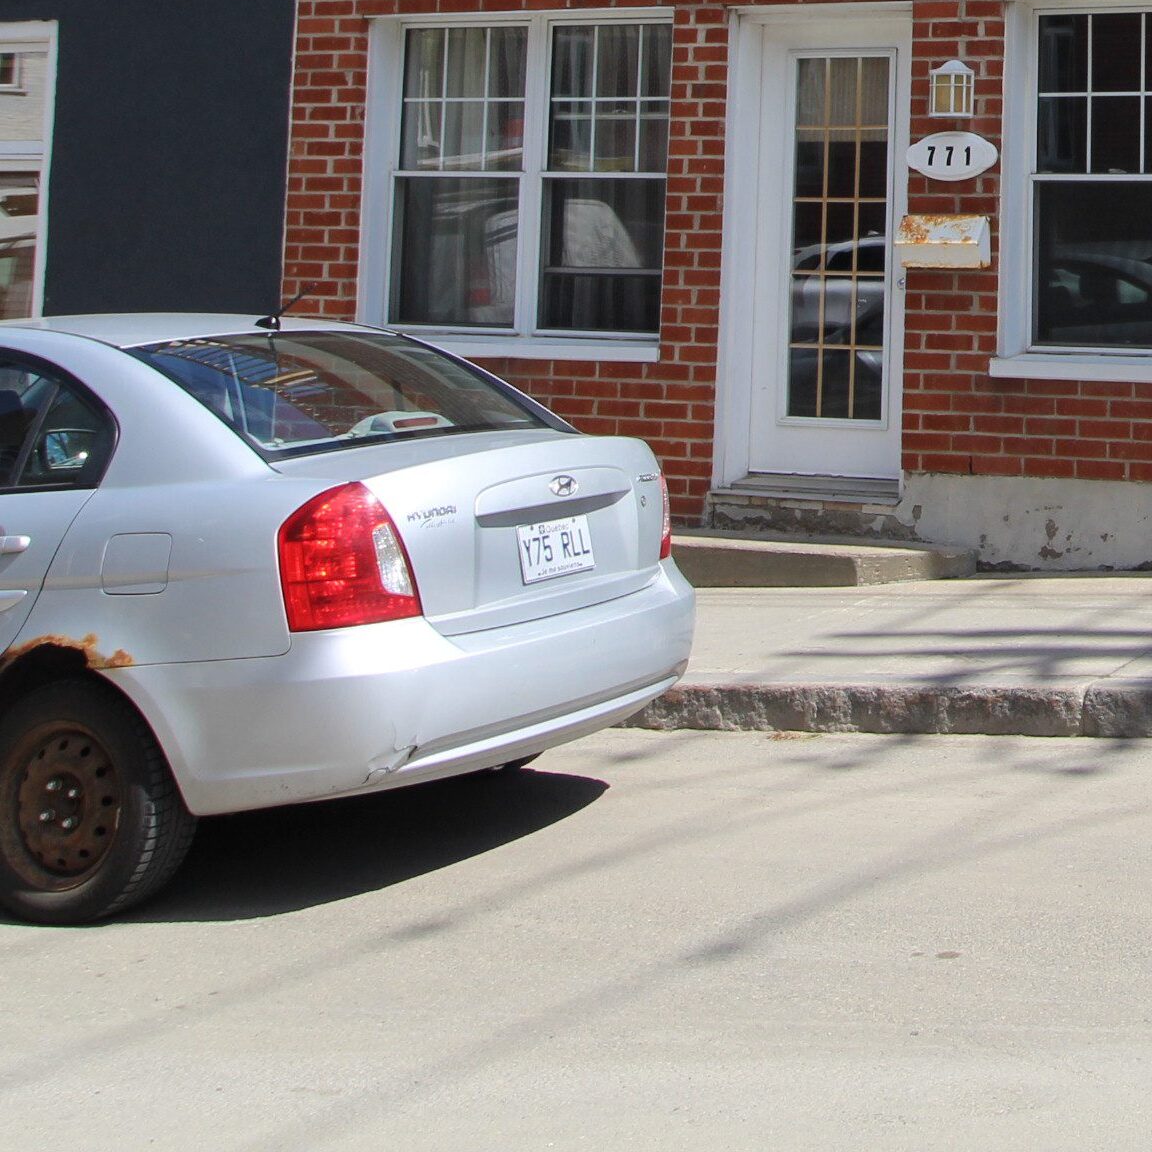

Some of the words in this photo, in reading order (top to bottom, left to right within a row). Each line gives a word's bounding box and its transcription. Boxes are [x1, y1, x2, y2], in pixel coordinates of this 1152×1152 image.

[927, 146, 971, 166] 771
[407, 505, 457, 522] HYUNDAI
[523, 535, 553, 567] Y75
[561, 529, 590, 559] RLL
